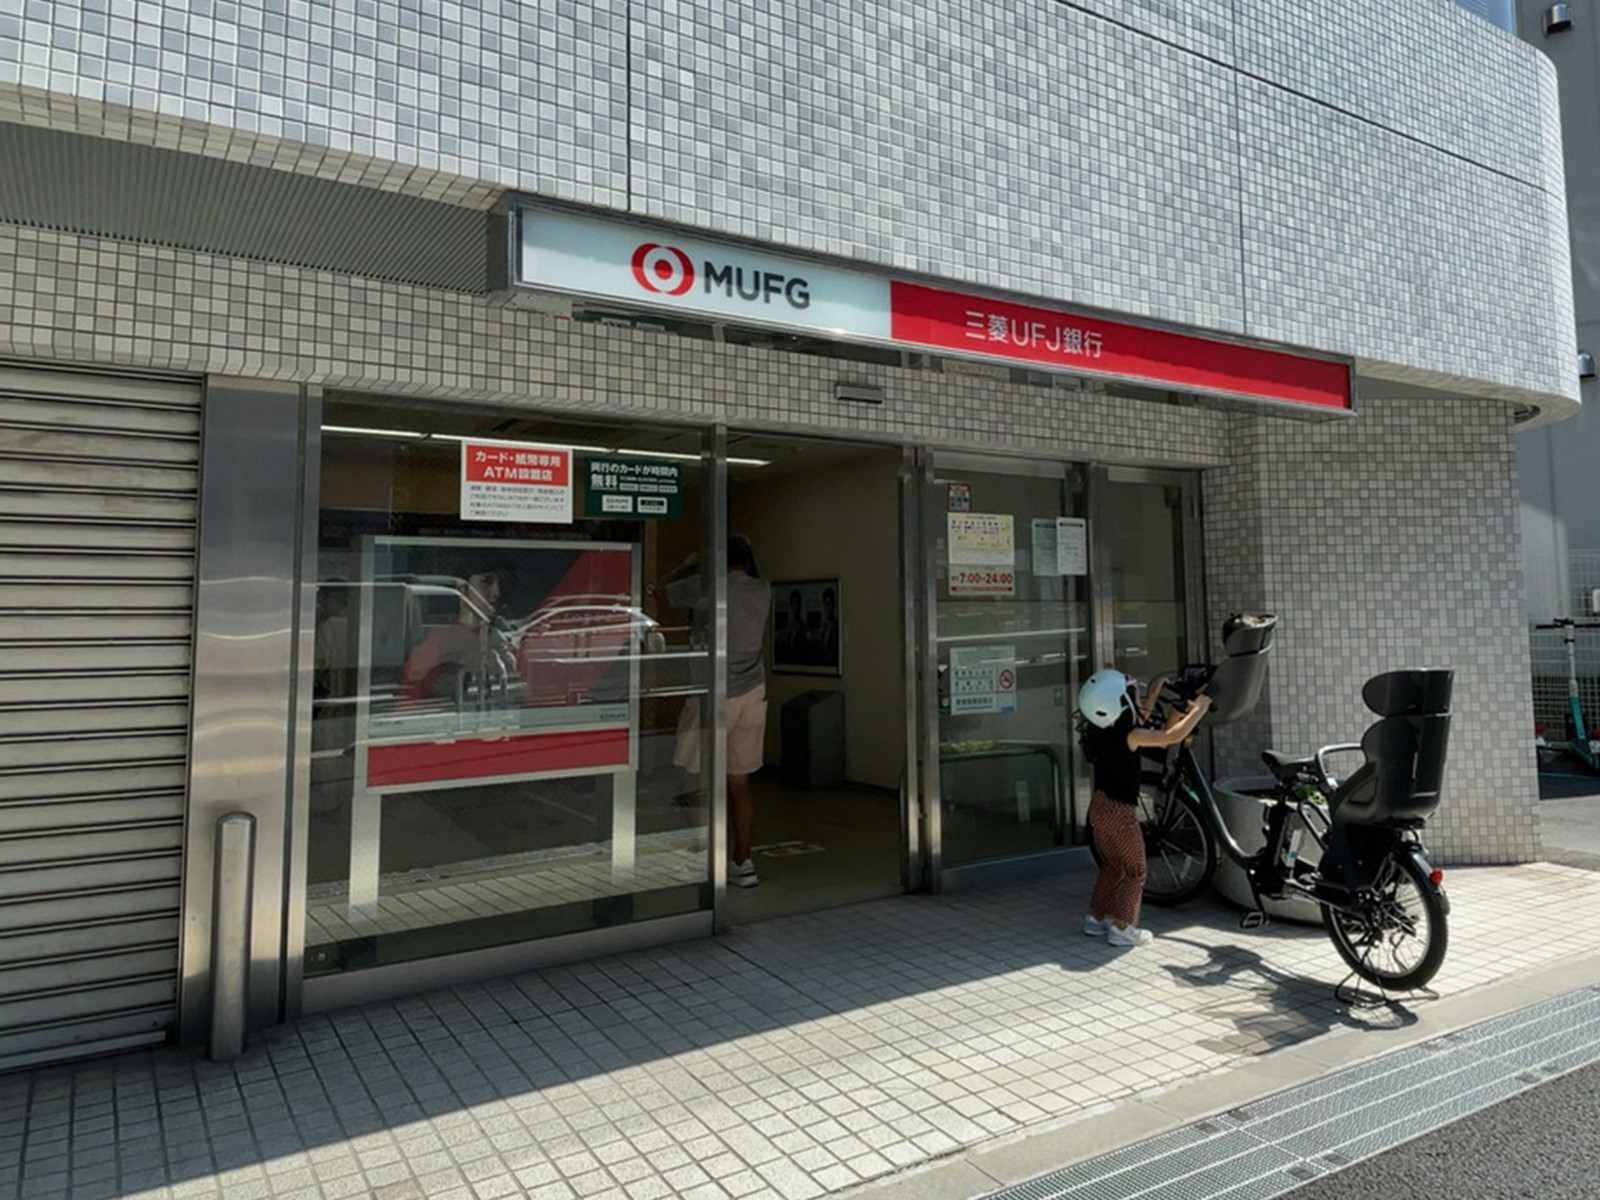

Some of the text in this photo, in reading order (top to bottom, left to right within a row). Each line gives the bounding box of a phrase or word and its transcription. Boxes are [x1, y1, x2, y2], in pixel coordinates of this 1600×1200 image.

[704, 261, 810, 310] MUFG
[965, 310, 1103, 358] 三菱UFJ銀行
